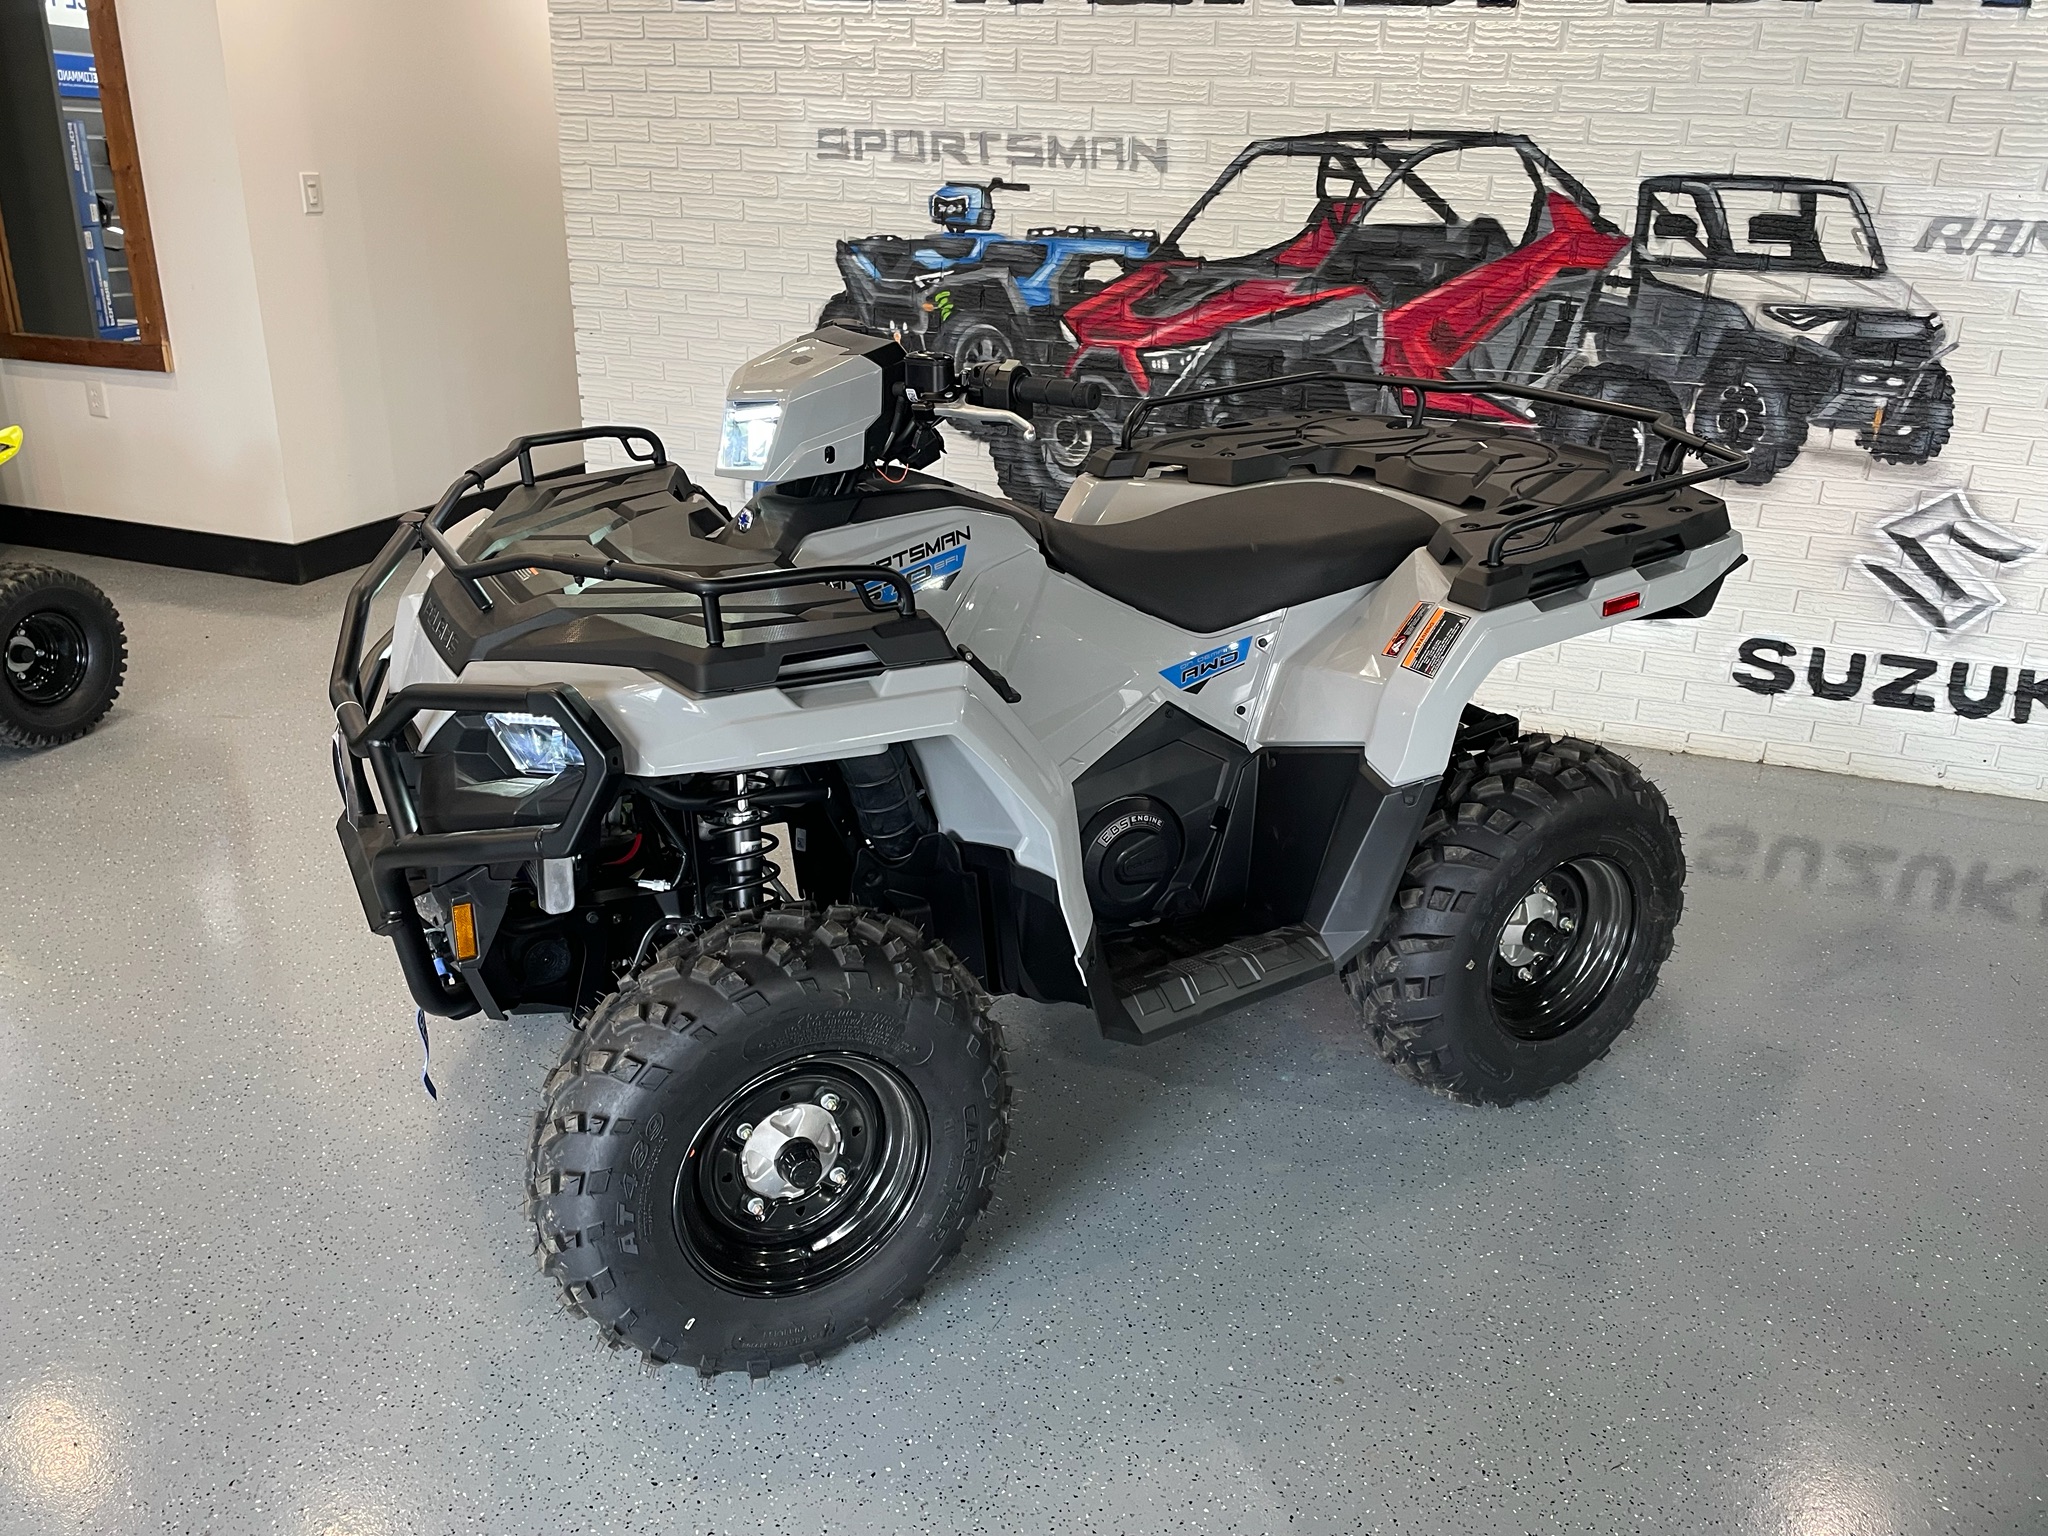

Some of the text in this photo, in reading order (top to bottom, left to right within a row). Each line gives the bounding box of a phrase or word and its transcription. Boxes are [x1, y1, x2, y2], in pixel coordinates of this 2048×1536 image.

[817, 127, 1168, 173] SPORTSMAN
[933, 554, 959, 570] EFI
[1180, 650, 1240, 684] AWD
[1732, 637, 2048, 723] SUZUK
[1100, 818, 1130, 846] EBS
[1130, 814, 1163, 828] ENGINE
